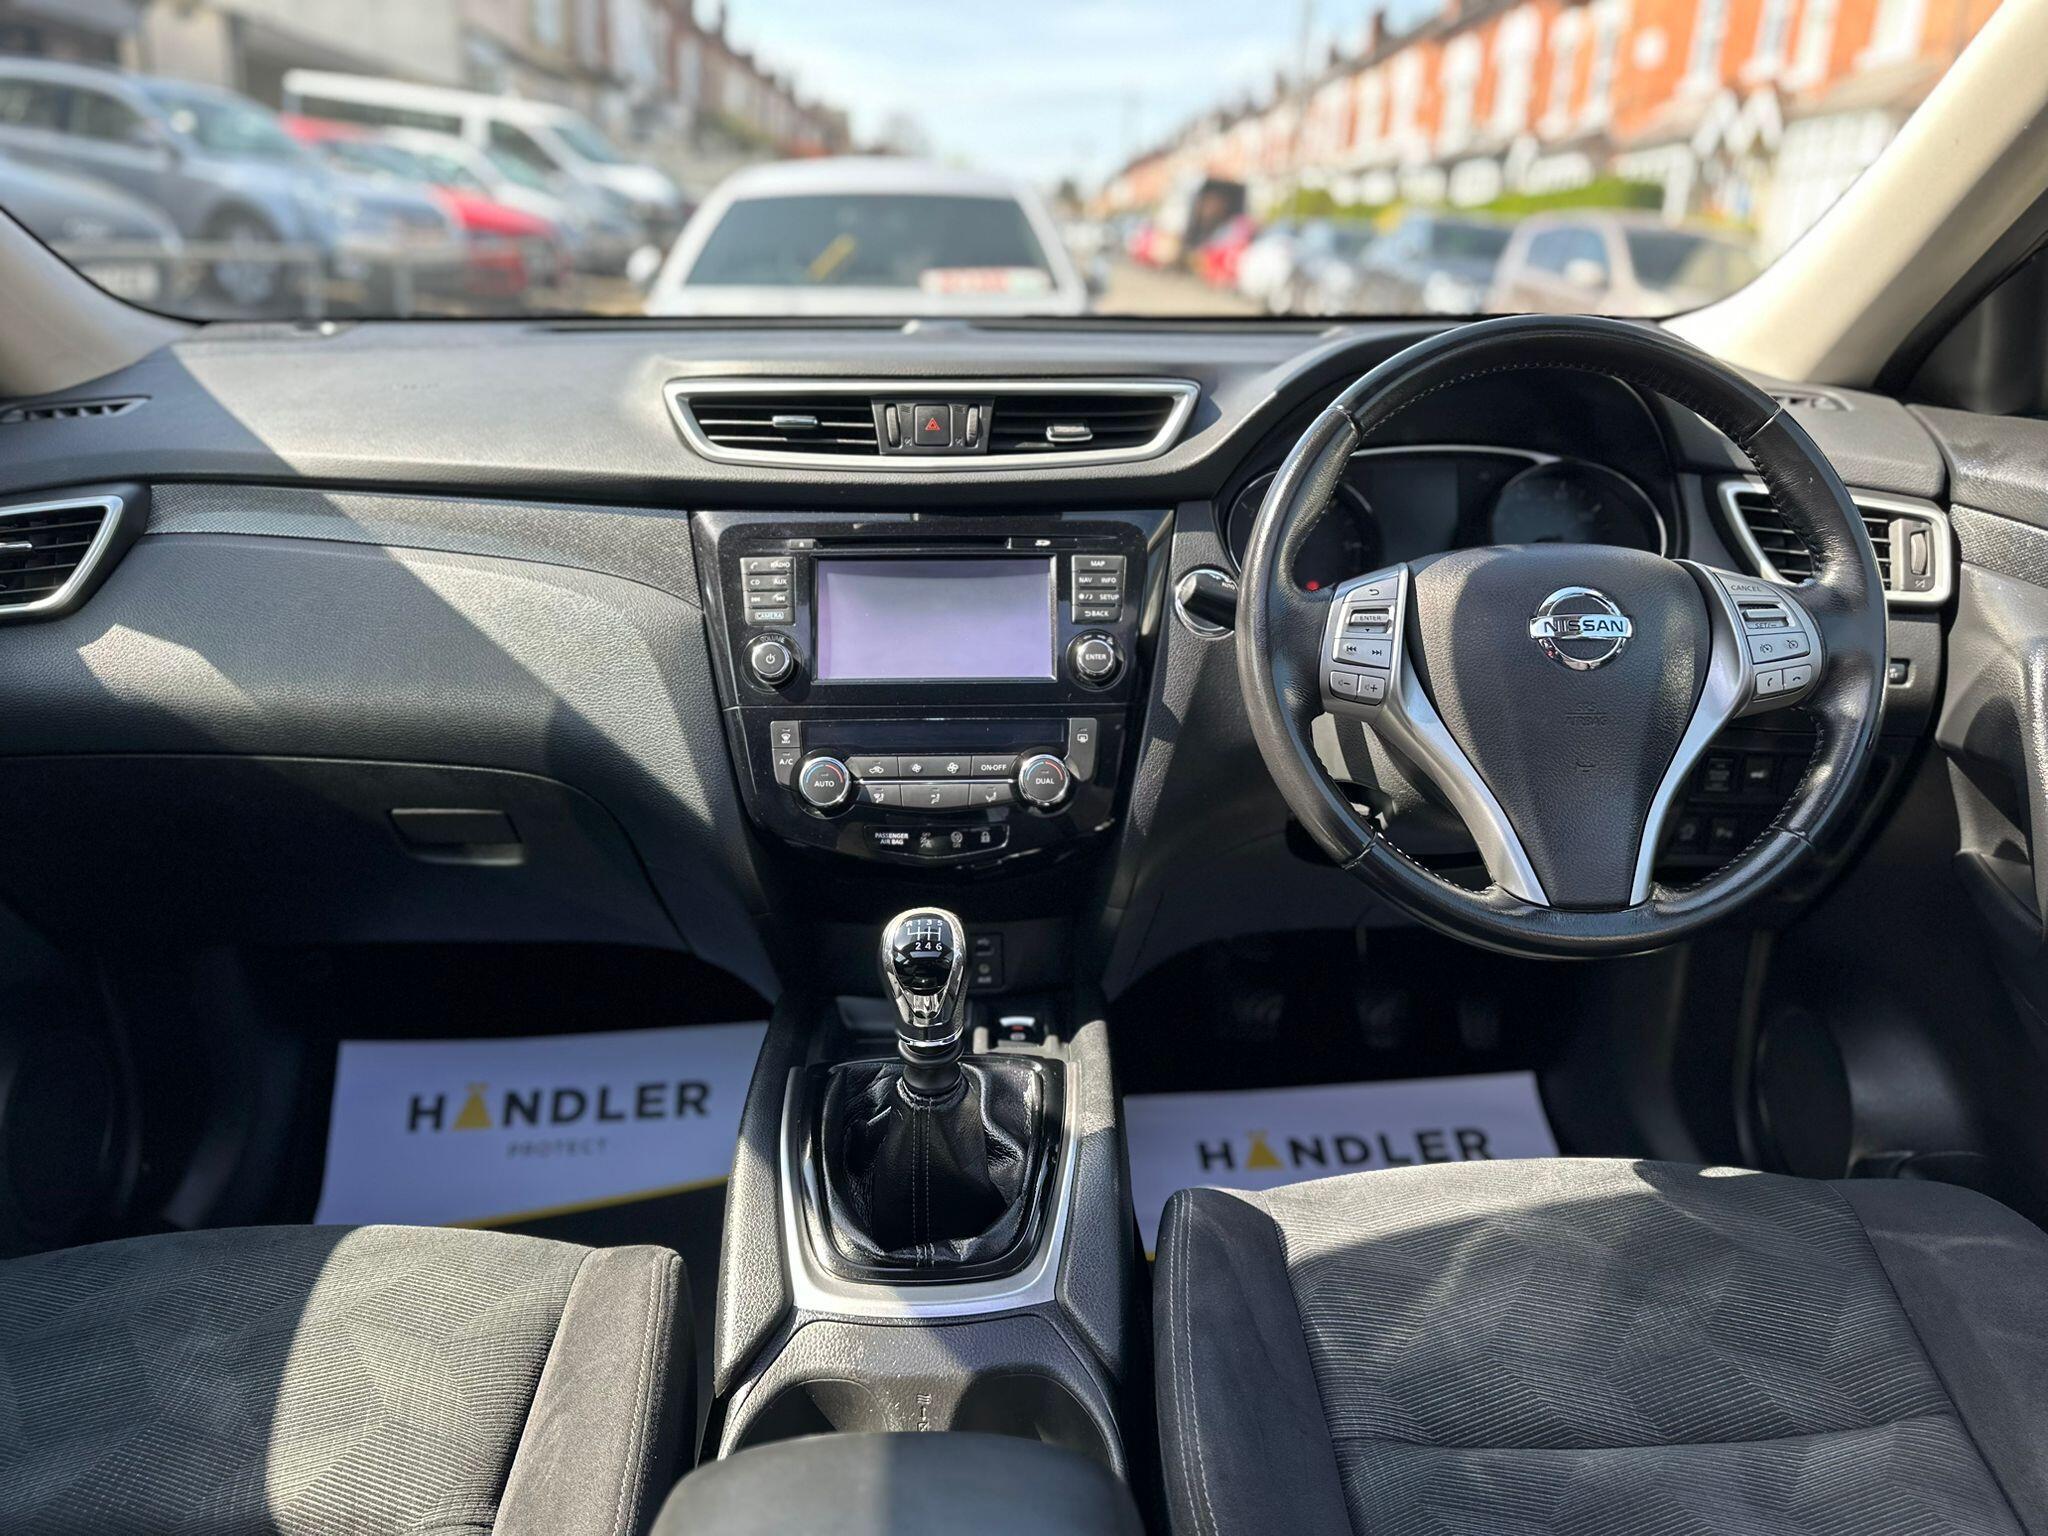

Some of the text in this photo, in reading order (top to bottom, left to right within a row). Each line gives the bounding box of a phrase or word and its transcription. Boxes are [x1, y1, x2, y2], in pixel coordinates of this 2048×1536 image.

[773, 577, 788, 585] AUX
[1730, 584, 1762, 592] CANCEL
[1099, 593, 1120, 601] SETUP
[1544, 619, 1624, 633] NISSAN
[1085, 653, 1107, 661] ENTER
[814, 780, 835, 788] AUTO
[1035, 777, 1055, 785] DUAL
[915, 942, 942, 951] 2 4 6
